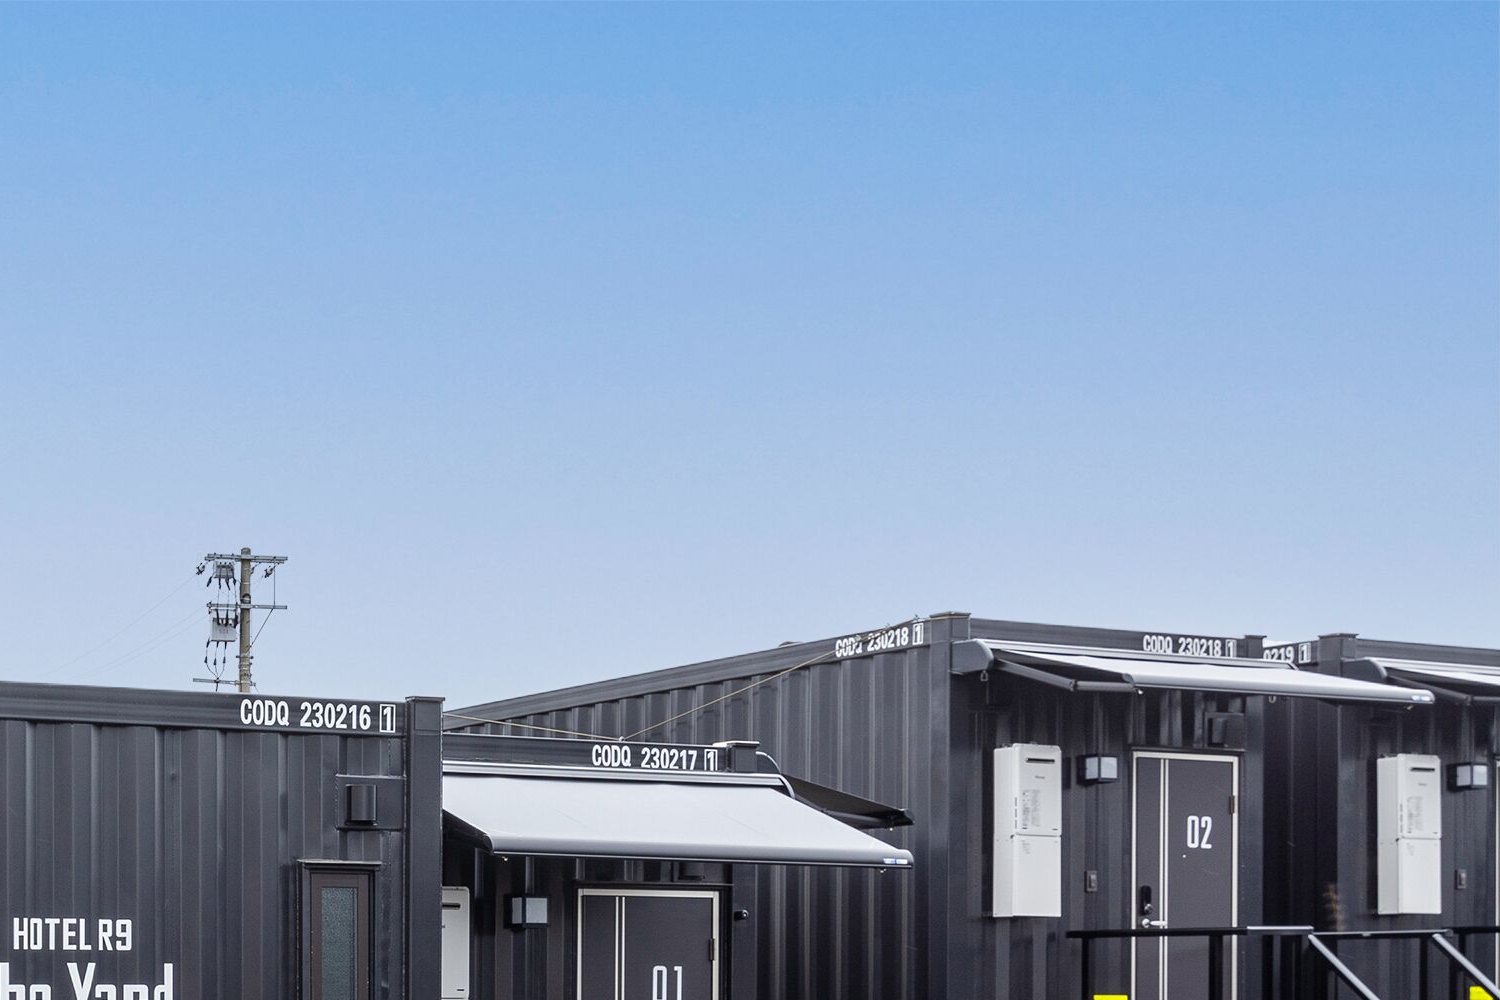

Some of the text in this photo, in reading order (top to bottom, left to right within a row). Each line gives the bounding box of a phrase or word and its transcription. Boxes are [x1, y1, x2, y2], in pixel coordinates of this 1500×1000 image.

[867, 626, 909, 652] 230218
[1178, 637, 1222, 658] 230218
[240, 699, 289, 726] CODQ
[300, 702, 371, 730] 230216
[592, 744, 631, 767] CODQ
[641, 747, 697, 770] 230217
[1187, 815, 1212, 849] 02
[13, 917, 132, 950] HOTEL R9
